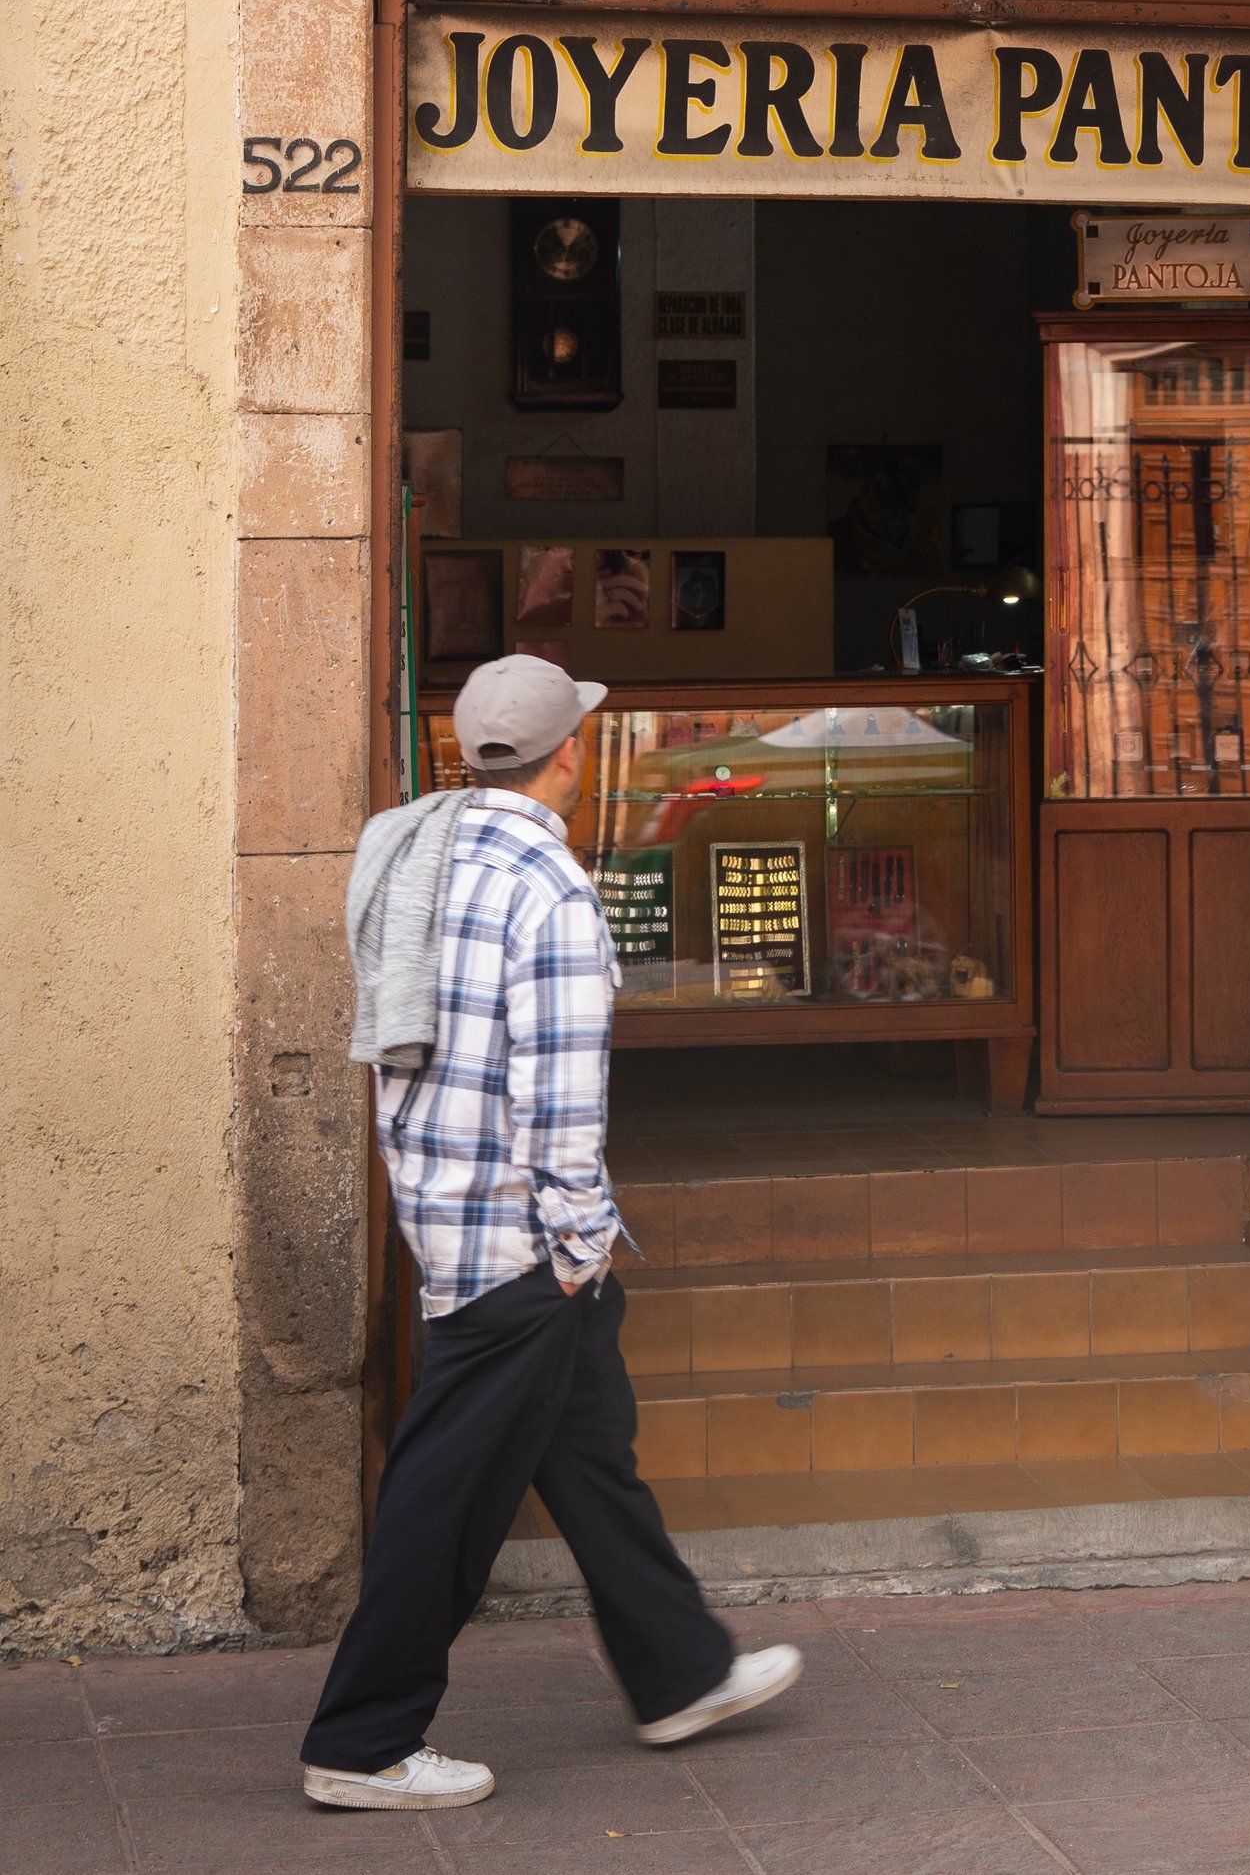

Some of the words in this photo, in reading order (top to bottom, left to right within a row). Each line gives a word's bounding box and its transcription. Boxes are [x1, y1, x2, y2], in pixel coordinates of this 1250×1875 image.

[414, 31, 962, 163] JOYERIA
[242, 136, 362, 194] 522
[1111, 262, 1243, 290] PANTOJA
